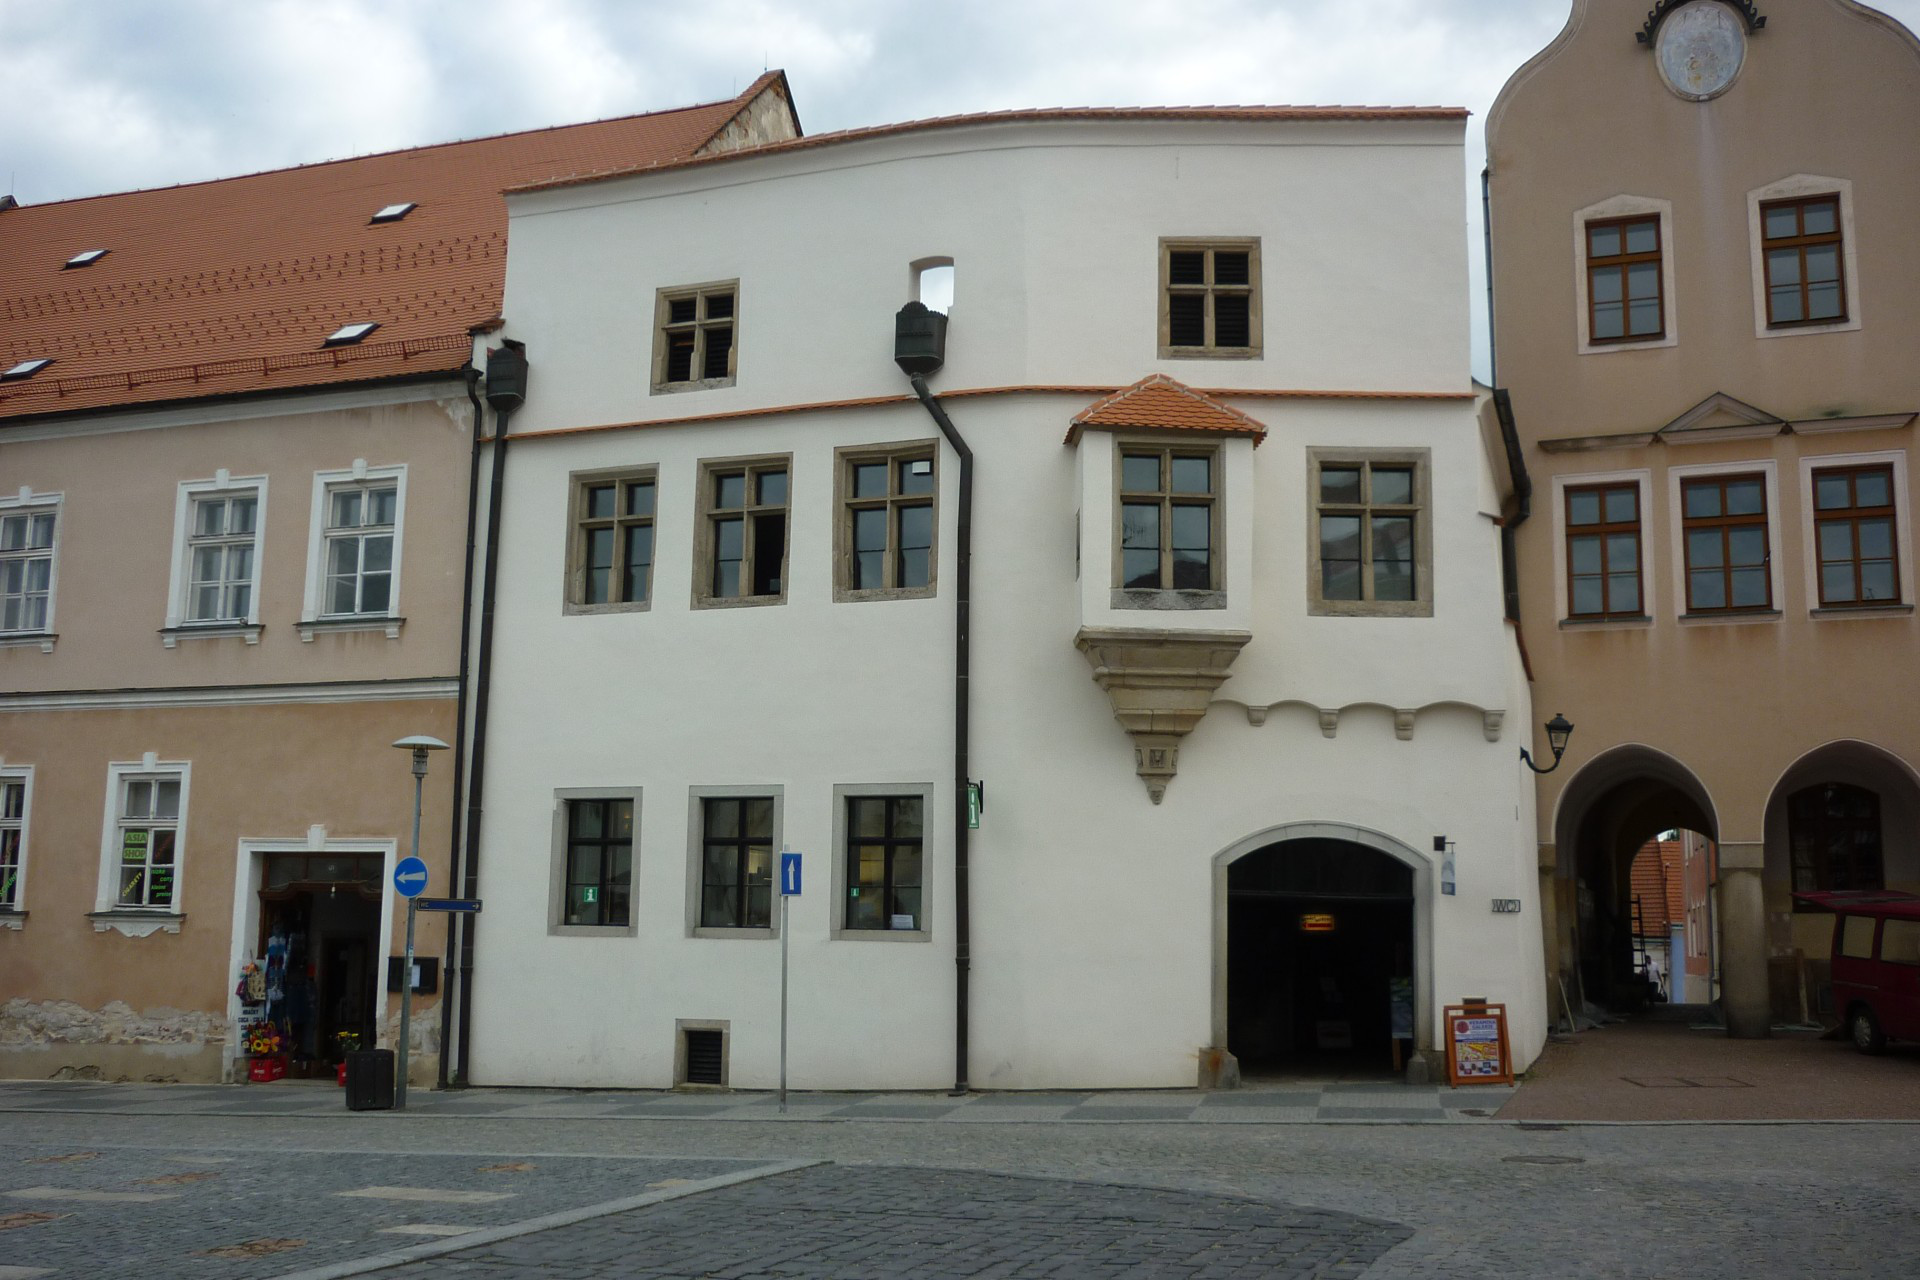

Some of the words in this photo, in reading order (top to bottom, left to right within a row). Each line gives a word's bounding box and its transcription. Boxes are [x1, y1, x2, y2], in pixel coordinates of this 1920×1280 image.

[126, 833, 145, 842] ASIA
[124, 848, 145, 858] SHOP
[1495, 899, 1514, 912] WC
